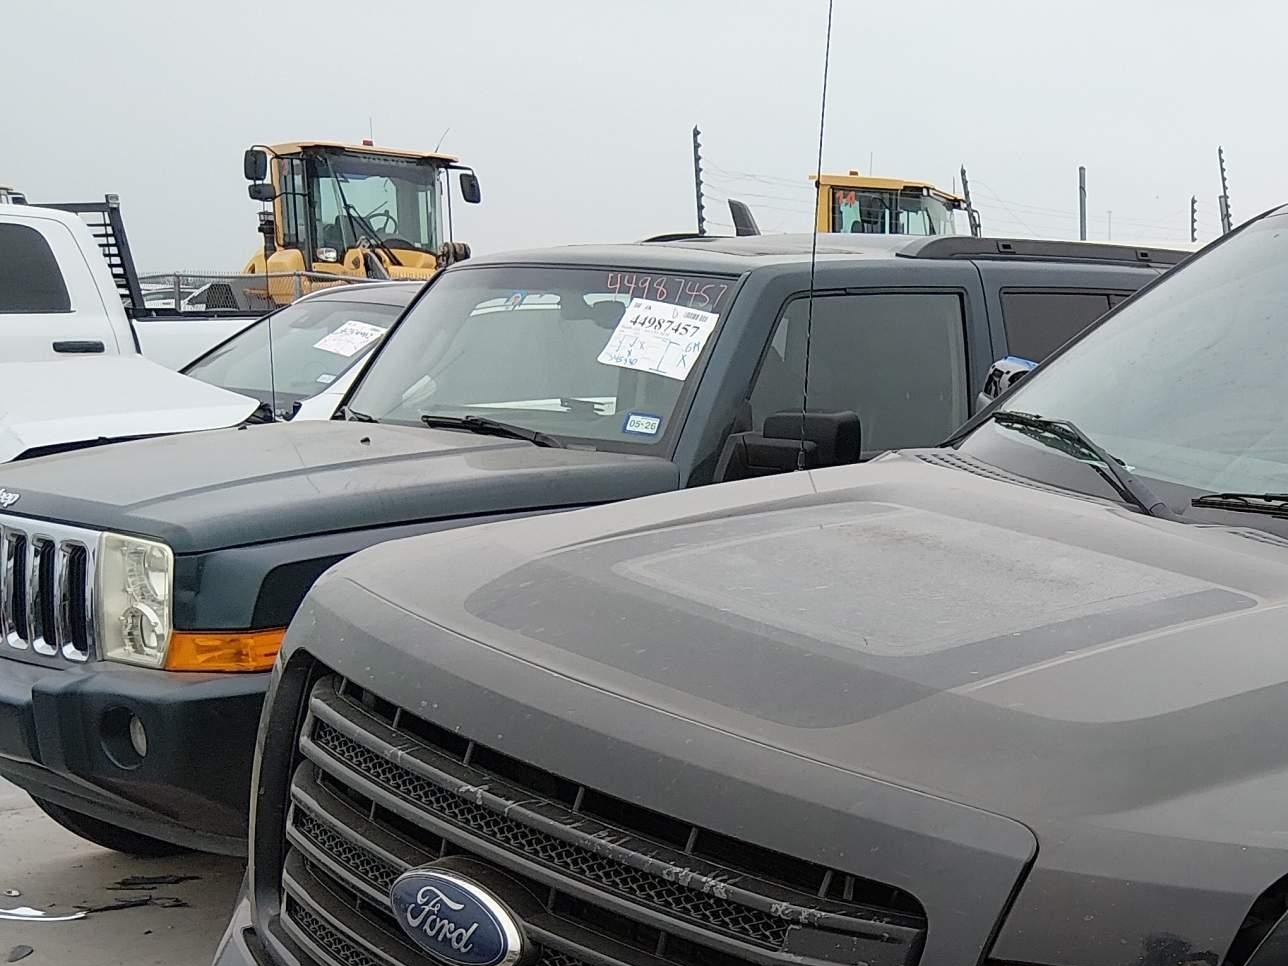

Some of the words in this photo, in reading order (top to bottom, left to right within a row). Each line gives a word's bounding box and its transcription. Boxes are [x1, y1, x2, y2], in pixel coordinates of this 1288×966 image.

[607, 272, 728, 307] 44987457
[630, 314, 700, 338] 44987457
[407, 886, 479, 953] Ford
